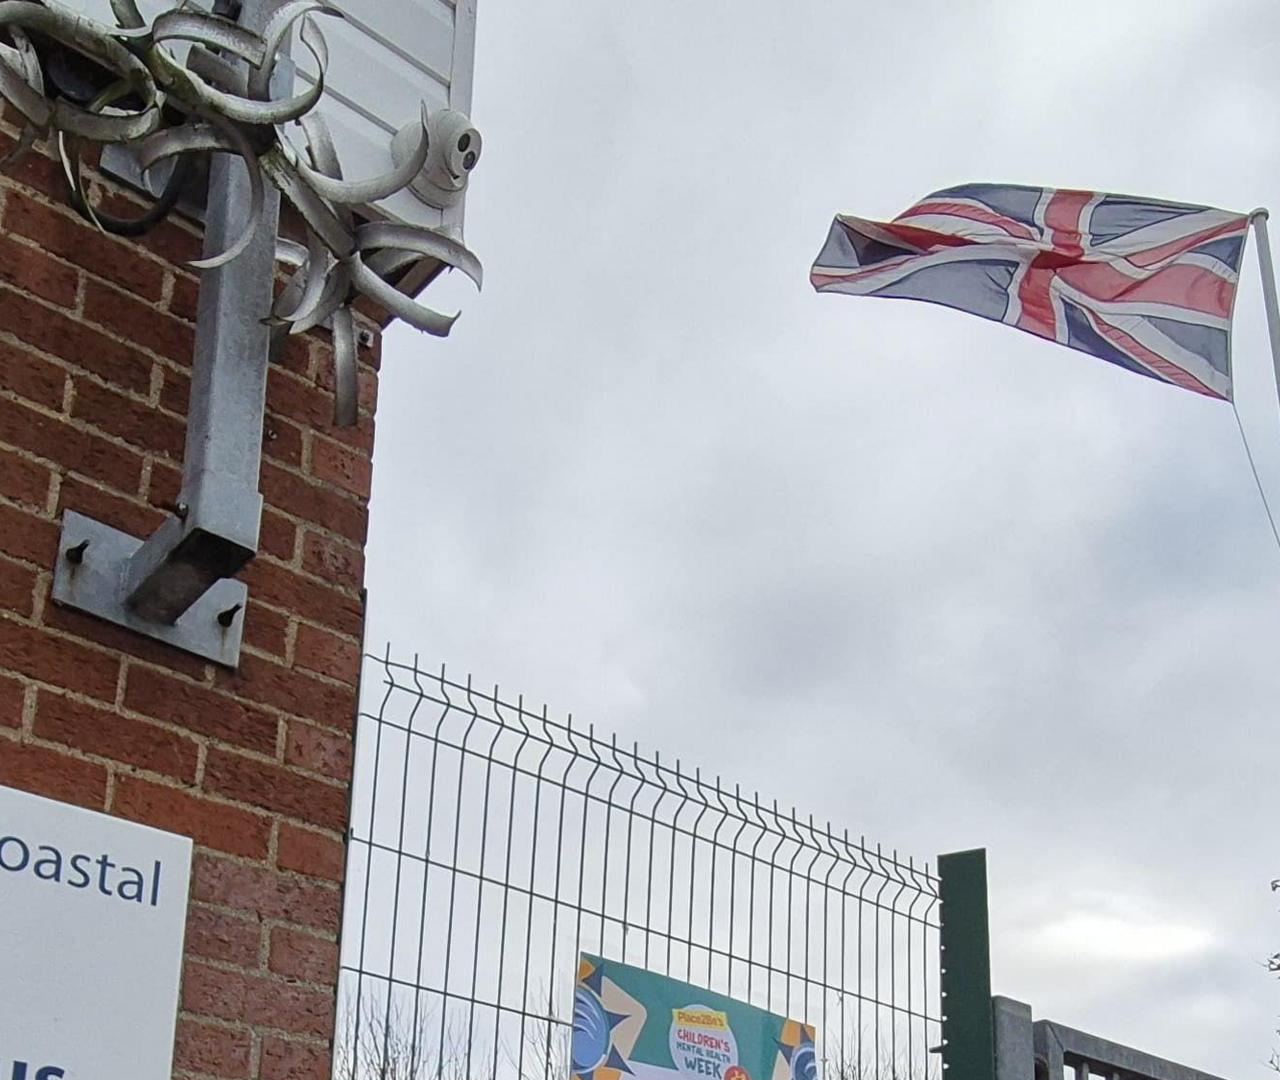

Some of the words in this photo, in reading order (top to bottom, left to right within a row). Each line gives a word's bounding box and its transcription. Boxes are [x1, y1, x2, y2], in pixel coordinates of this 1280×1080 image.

[676, 1041, 704, 1057] MENTAL
[677, 1028, 730, 1053] CHILDREN'S
[684, 1056, 722, 1080] WEEK
